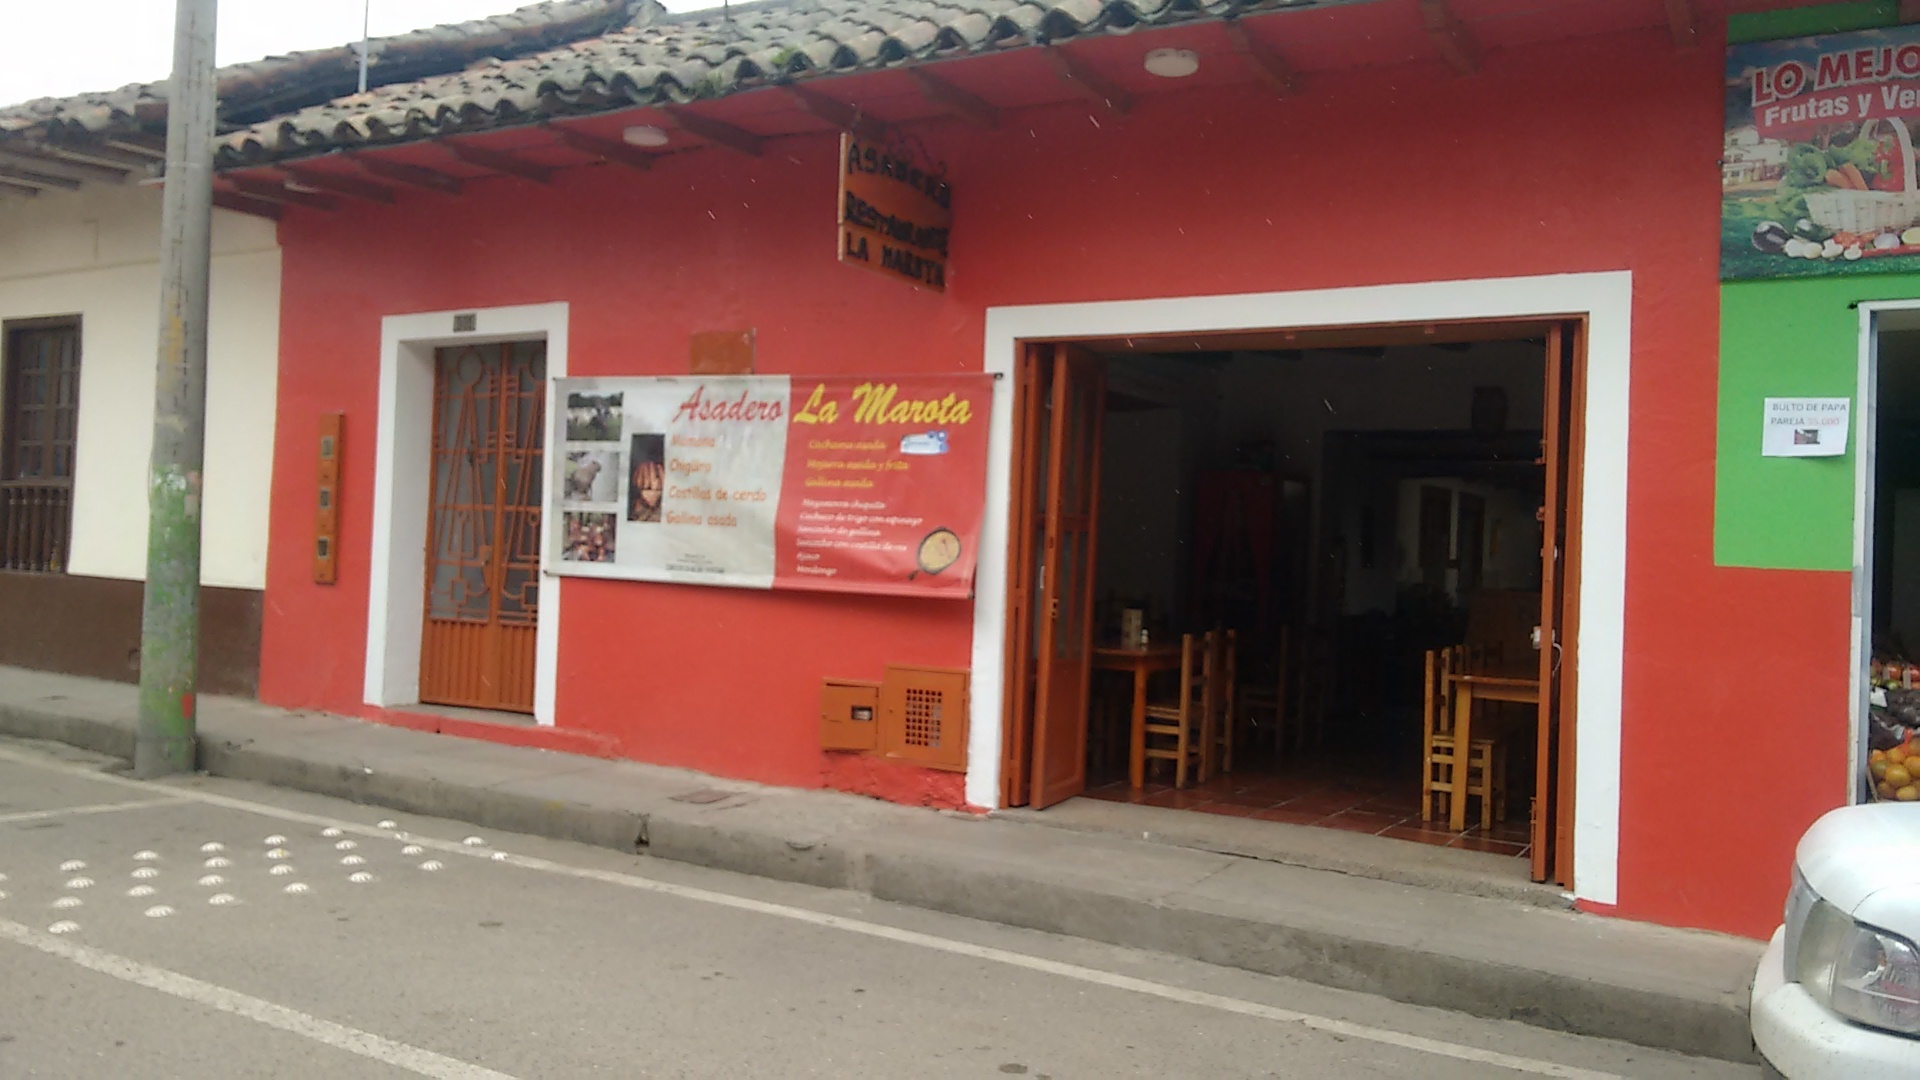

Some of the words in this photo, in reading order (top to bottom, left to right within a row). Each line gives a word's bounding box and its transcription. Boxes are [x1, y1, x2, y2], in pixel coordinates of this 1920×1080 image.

[1753, 62, 1804, 103] LO
[1765, 95, 1850, 127] Frutas
[1858, 93, 1872, 117] y
[846, 231, 869, 262] LA
[672, 384, 784, 423] Asadero
[792, 382, 839, 424] La
[852, 381, 974, 425] Marota
[1772, 402, 1804, 412] BULTO
[1806, 402, 1819, 412] DE
[1821, 402, 1847, 412] PAPA
[1770, 417, 1805, 426] PAREJA
[669, 484, 711, 500] Costillas
[715, 487, 728, 500] de
